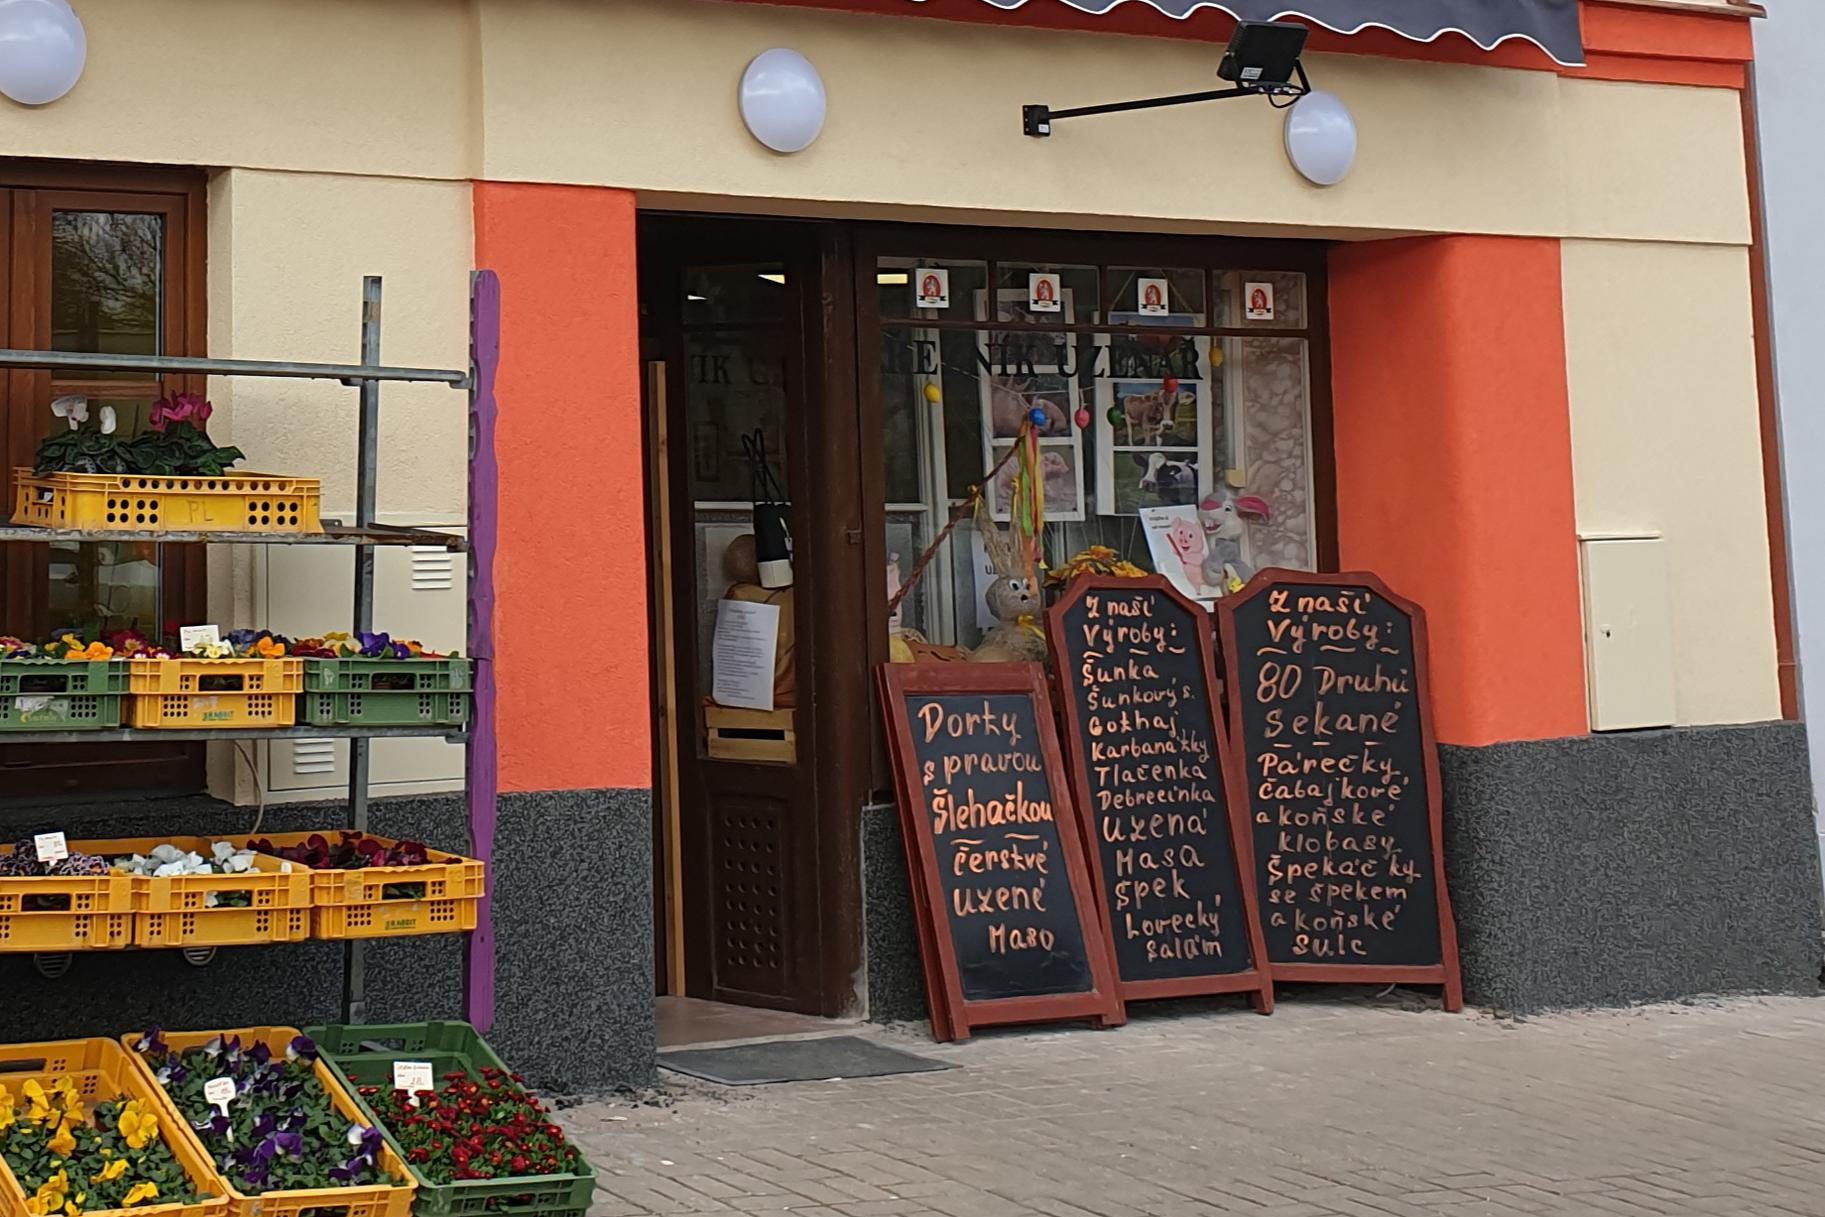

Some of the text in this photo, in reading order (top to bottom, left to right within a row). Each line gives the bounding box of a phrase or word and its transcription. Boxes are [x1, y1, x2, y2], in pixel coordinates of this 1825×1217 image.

[1107, 595, 1155, 617] naší
[1297, 590, 1371, 615] naší
[1082, 658, 1159, 686] Šunka
[1256, 661, 1409, 703] 80 Druhů
[1087, 677, 1177, 711] Šunkový
[918, 700, 1022, 746] Dorty
[1088, 710, 1179, 738] Gothaj
[1264, 701, 1402, 738] Sekané
[923, 751, 1041, 786] s pravou
[1094, 759, 1208, 787] Tlačenka
[1257, 748, 1401, 785] Párečky
[932, 780, 1053, 835] Šlehačkou
[1256, 802, 1395, 827] a koňské
[1116, 844, 1205, 877] Masa
[1269, 888, 1296, 904] se
[1126, 894, 1221, 939] Lovecký
[1270, 904, 1401, 932] a koňské
[988, 922, 1055, 955] Maso
